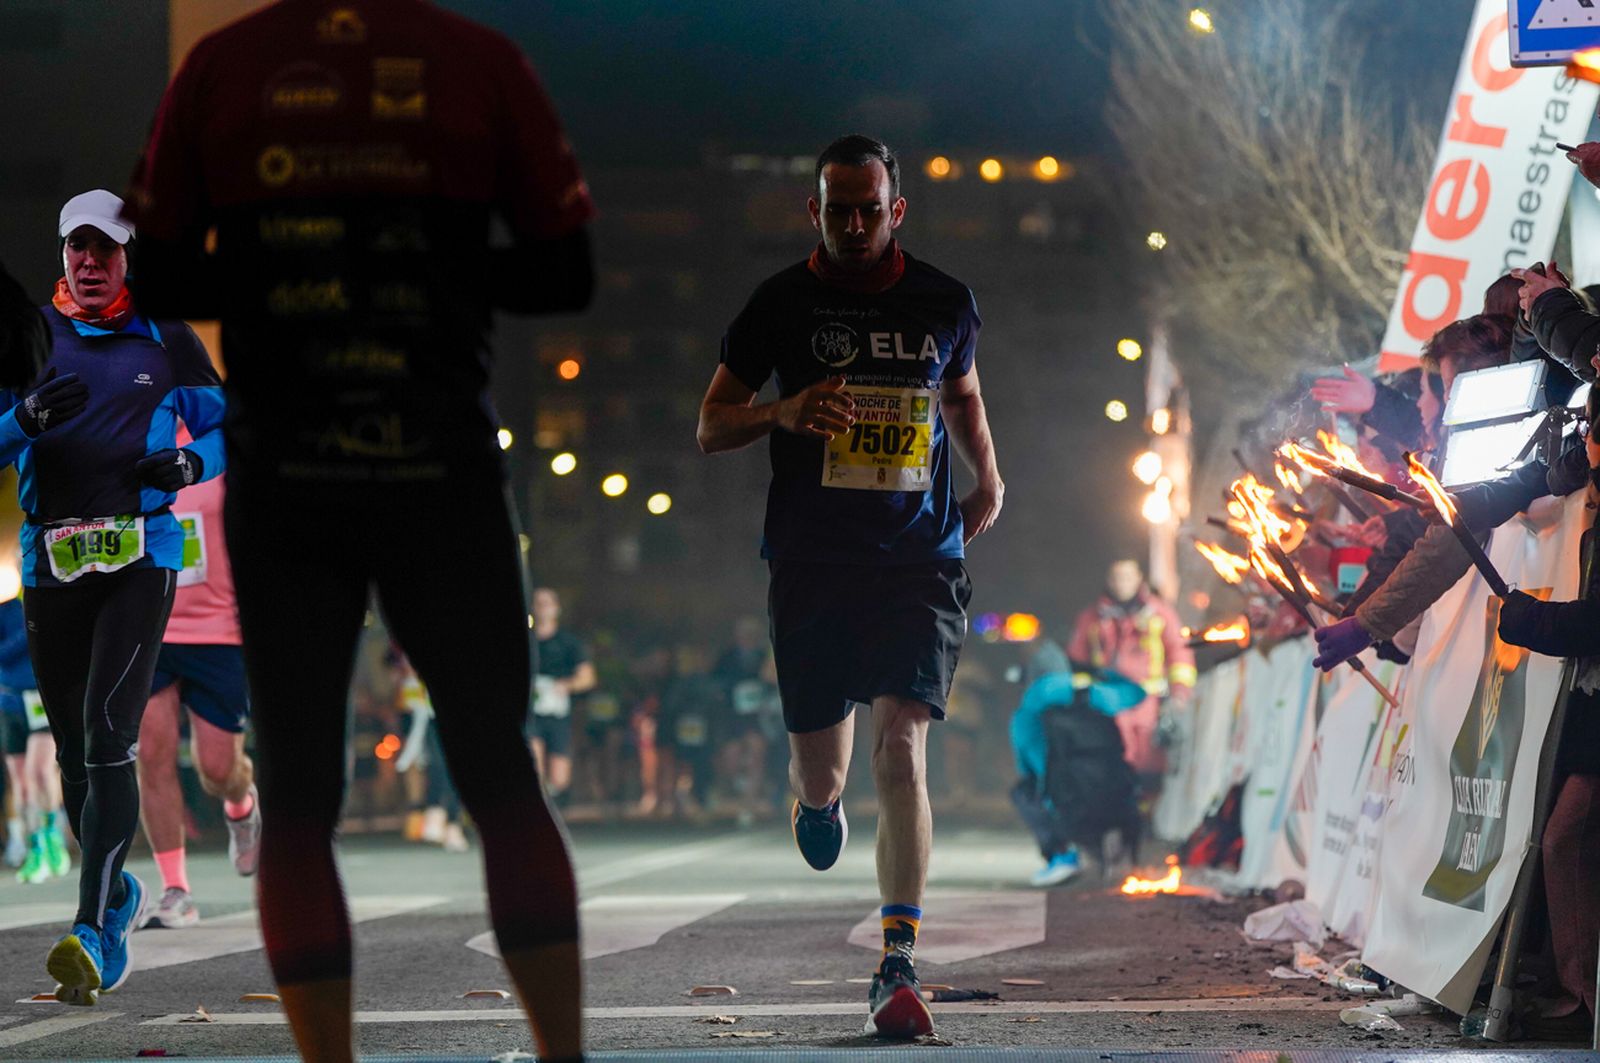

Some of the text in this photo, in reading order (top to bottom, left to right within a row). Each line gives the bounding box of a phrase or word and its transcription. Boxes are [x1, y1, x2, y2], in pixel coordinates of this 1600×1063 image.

[869, 331, 941, 365] ELA
[853, 397, 901, 410] NOCHE DE
[863, 408, 900, 422] ANTÓN
[849, 423, 917, 456] 7502
[54, 526, 72, 541] SAN
[66, 529, 121, 562] 1199
